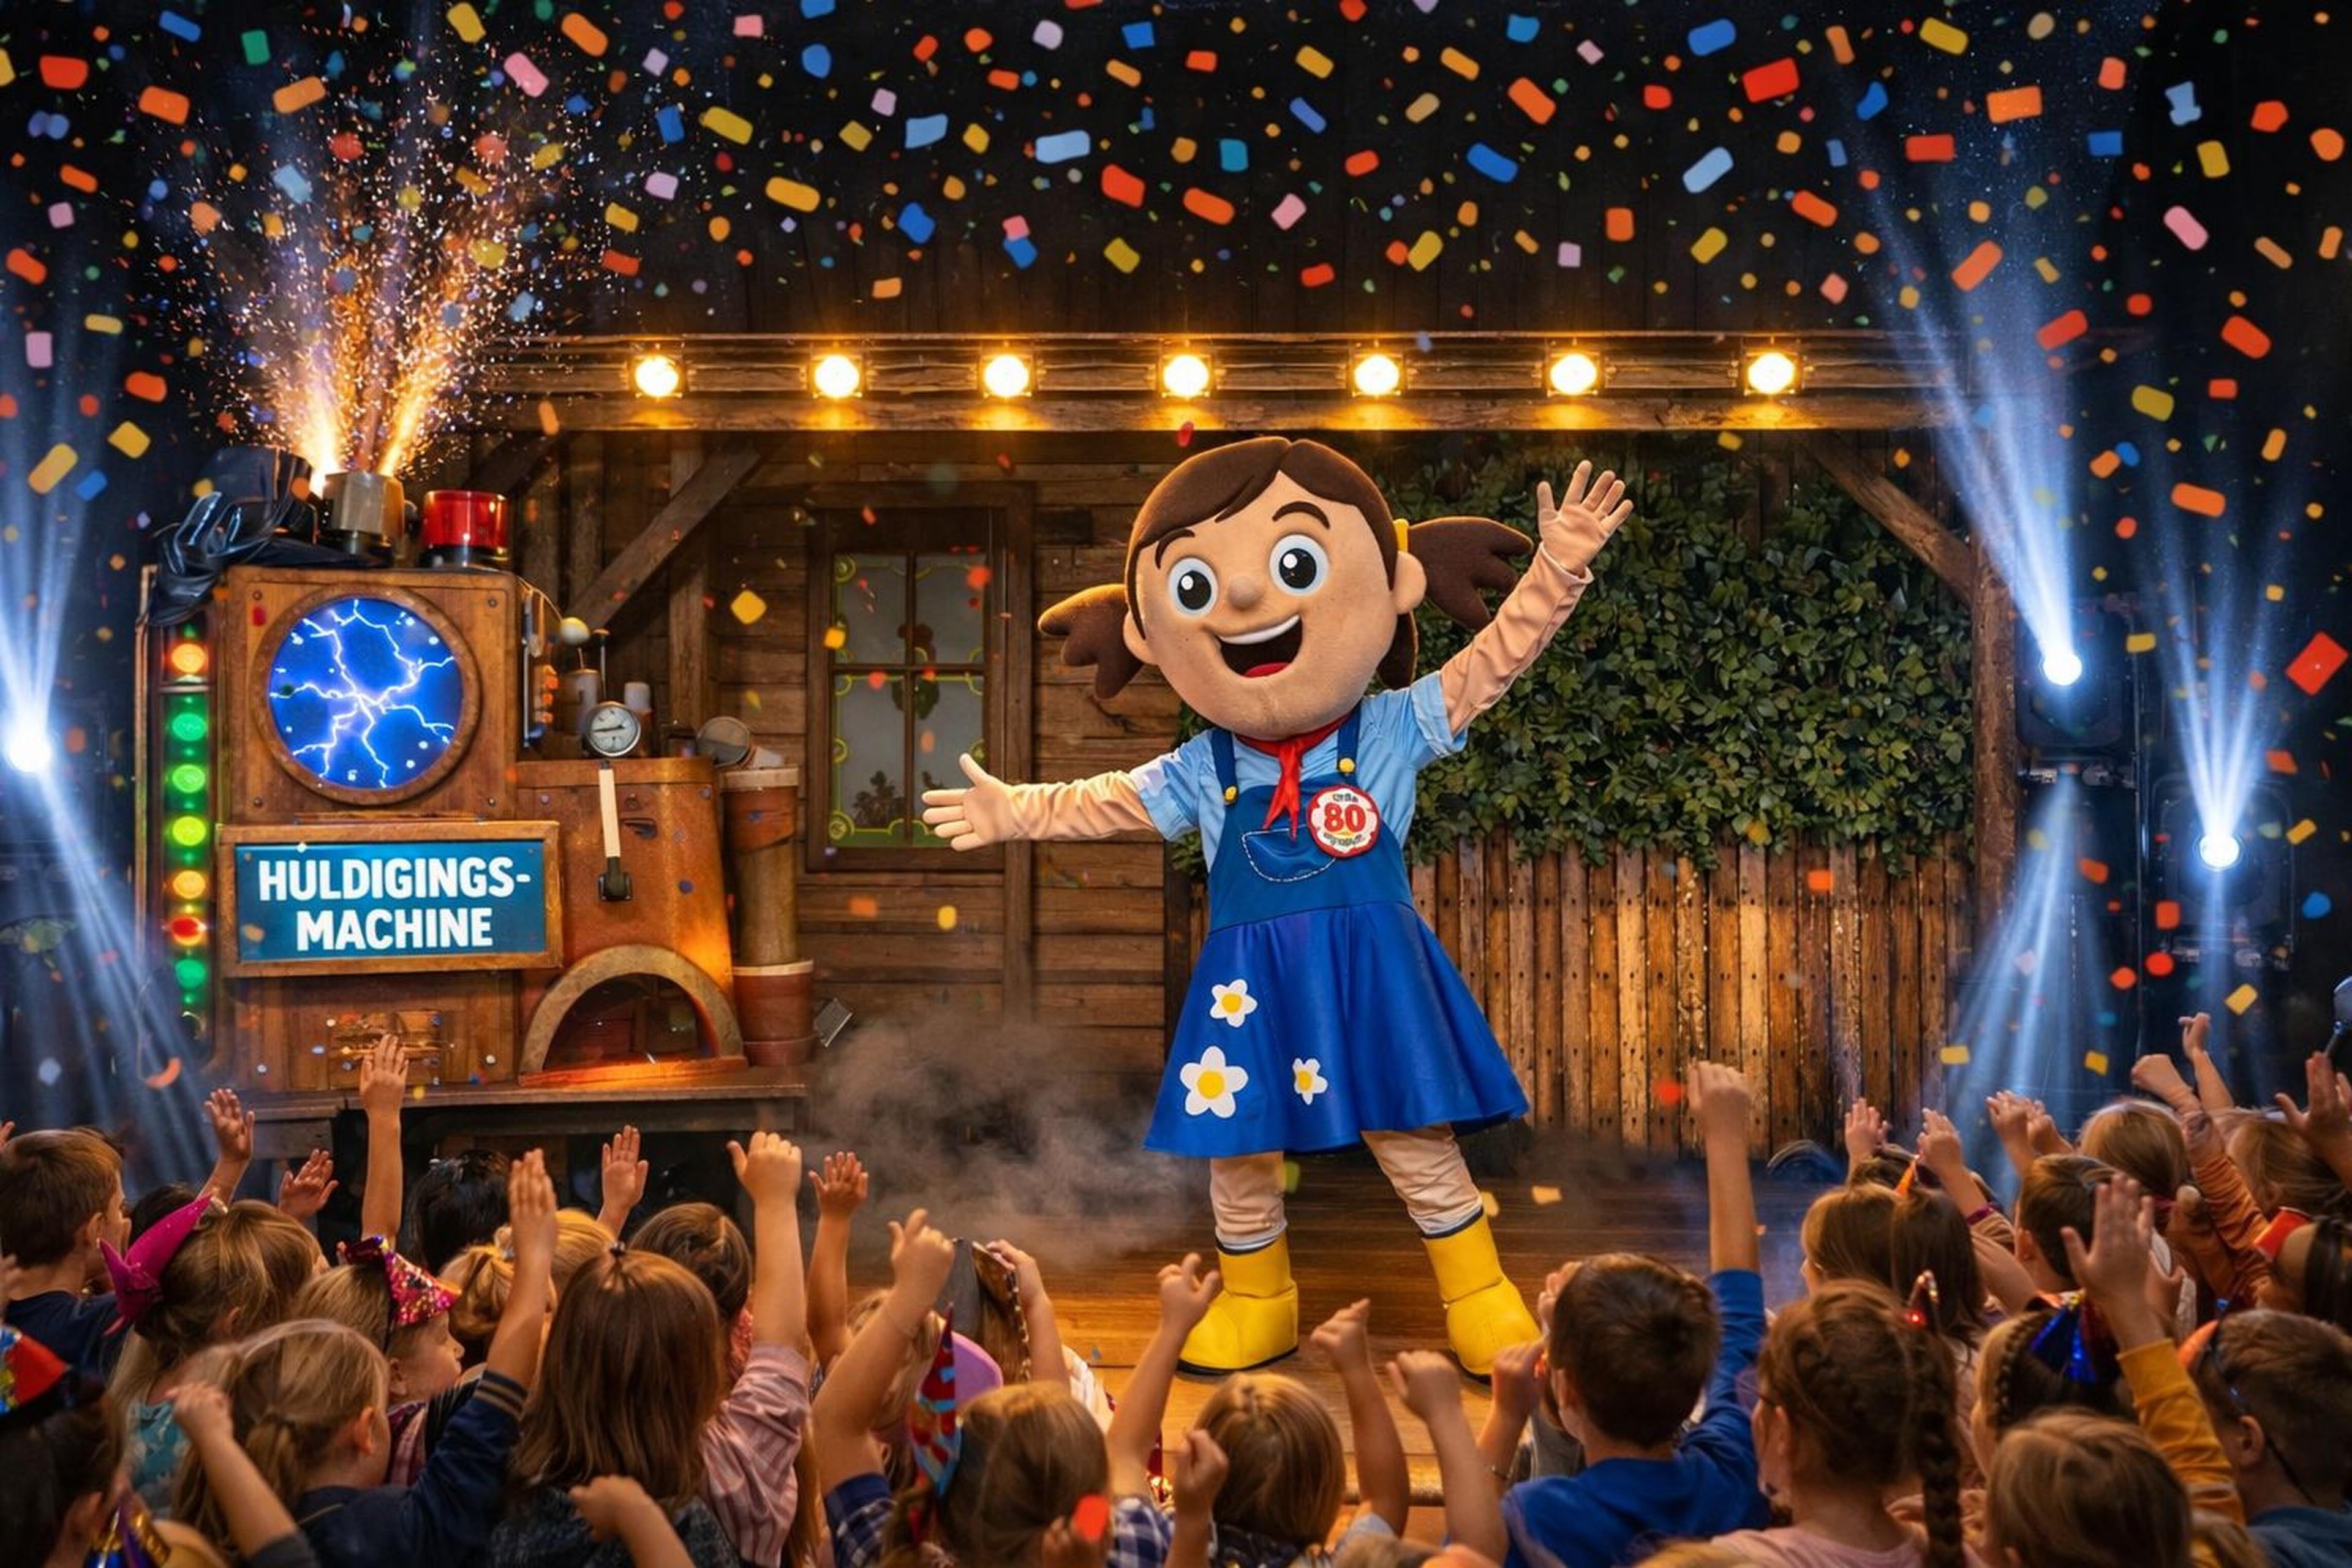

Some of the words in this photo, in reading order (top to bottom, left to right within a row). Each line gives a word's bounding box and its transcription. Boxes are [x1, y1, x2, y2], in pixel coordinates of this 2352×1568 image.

[1324, 803, 1366, 832] 80
[258, 857, 531, 901] HULDIGINGS-
[296, 908, 493, 951] MACHINE
